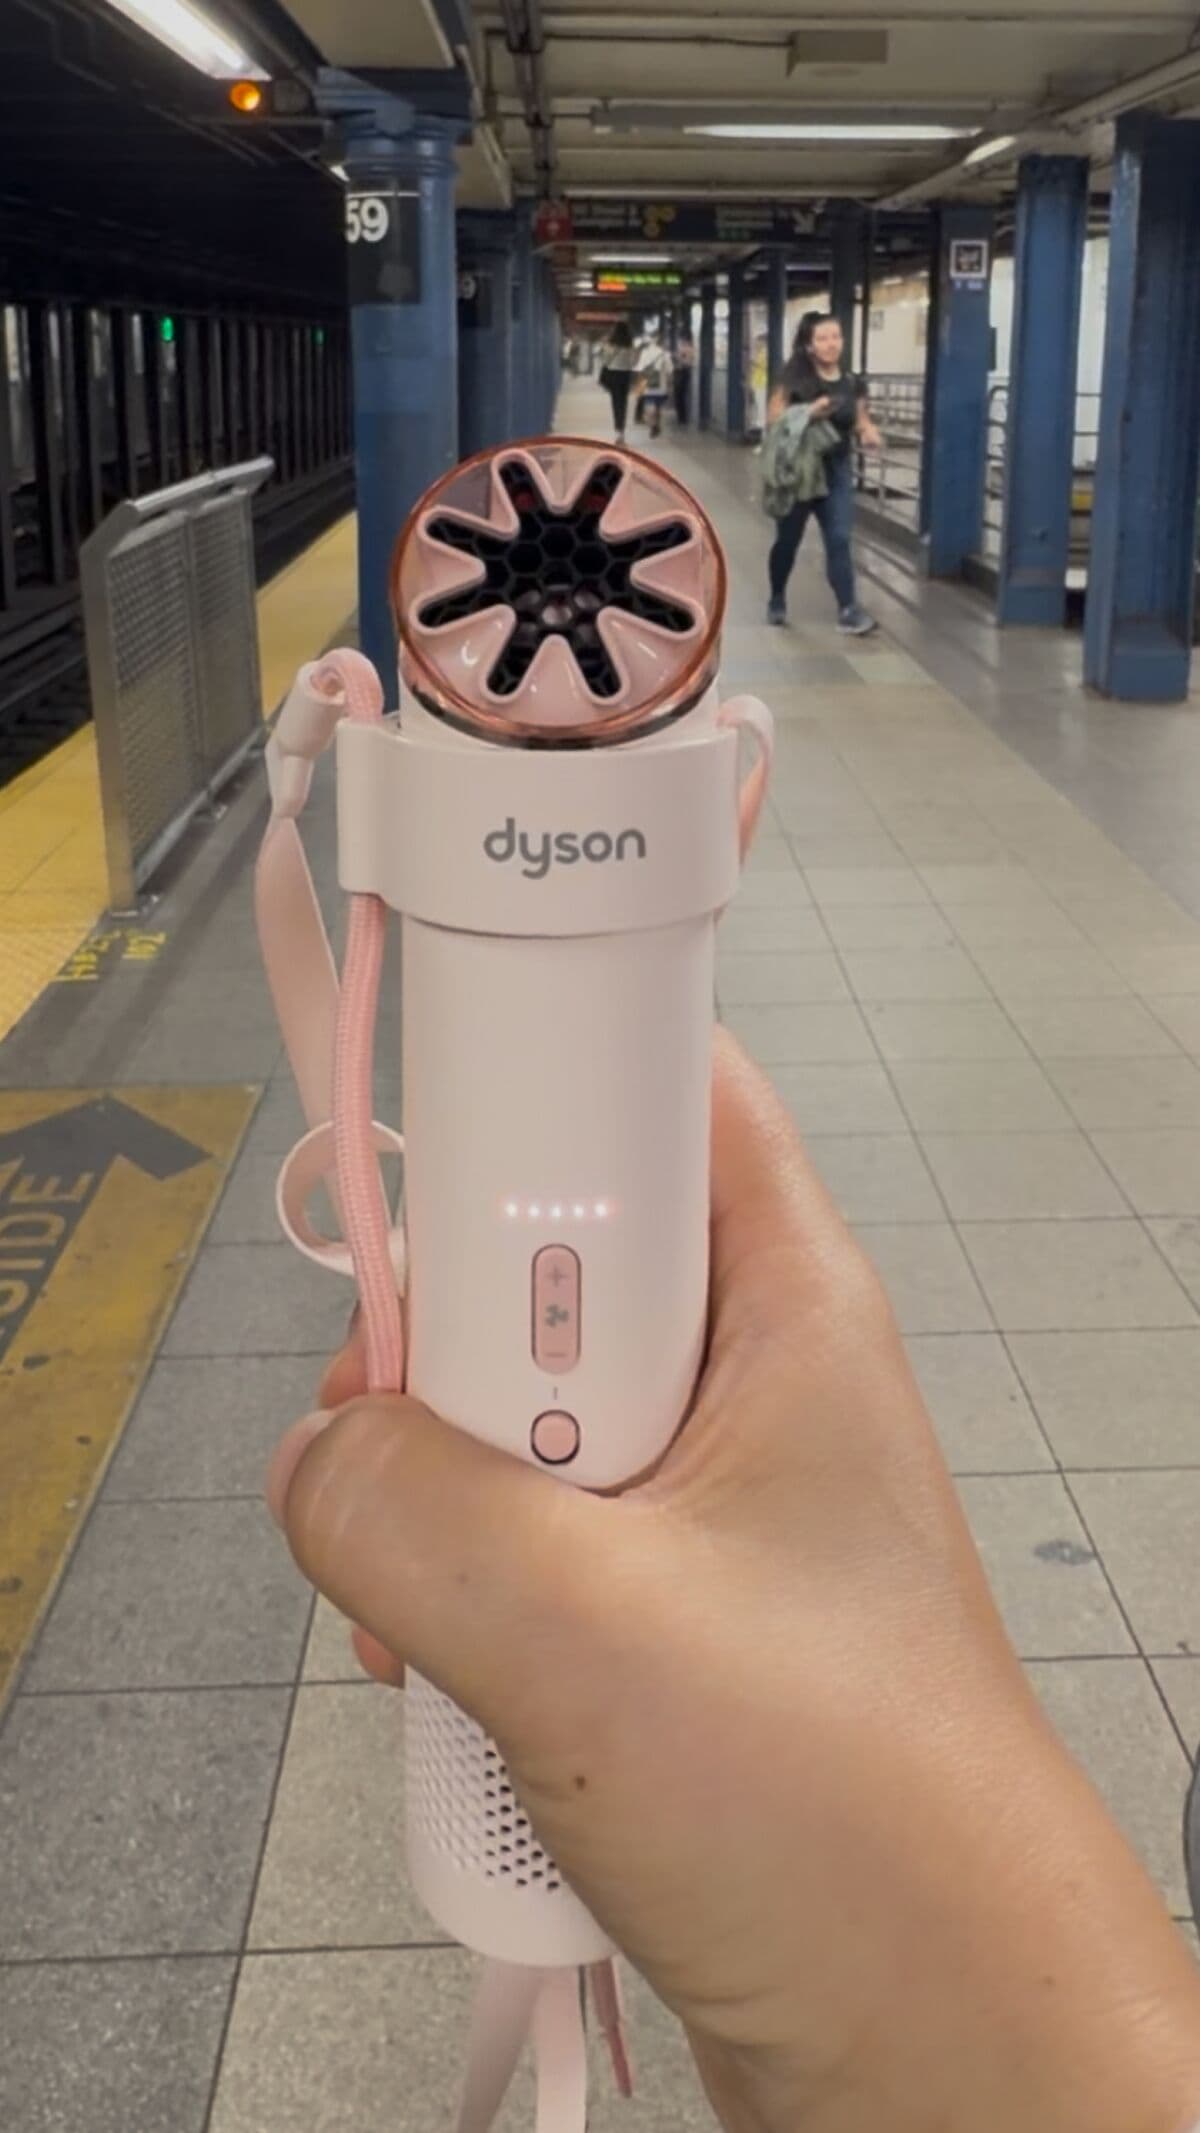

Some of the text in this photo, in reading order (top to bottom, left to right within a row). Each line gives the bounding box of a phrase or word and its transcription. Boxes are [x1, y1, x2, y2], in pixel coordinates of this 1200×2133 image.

[345, 197, 390, 243] 59
[459, 273, 477, 300] 9
[483, 817, 647, 880] dyson
